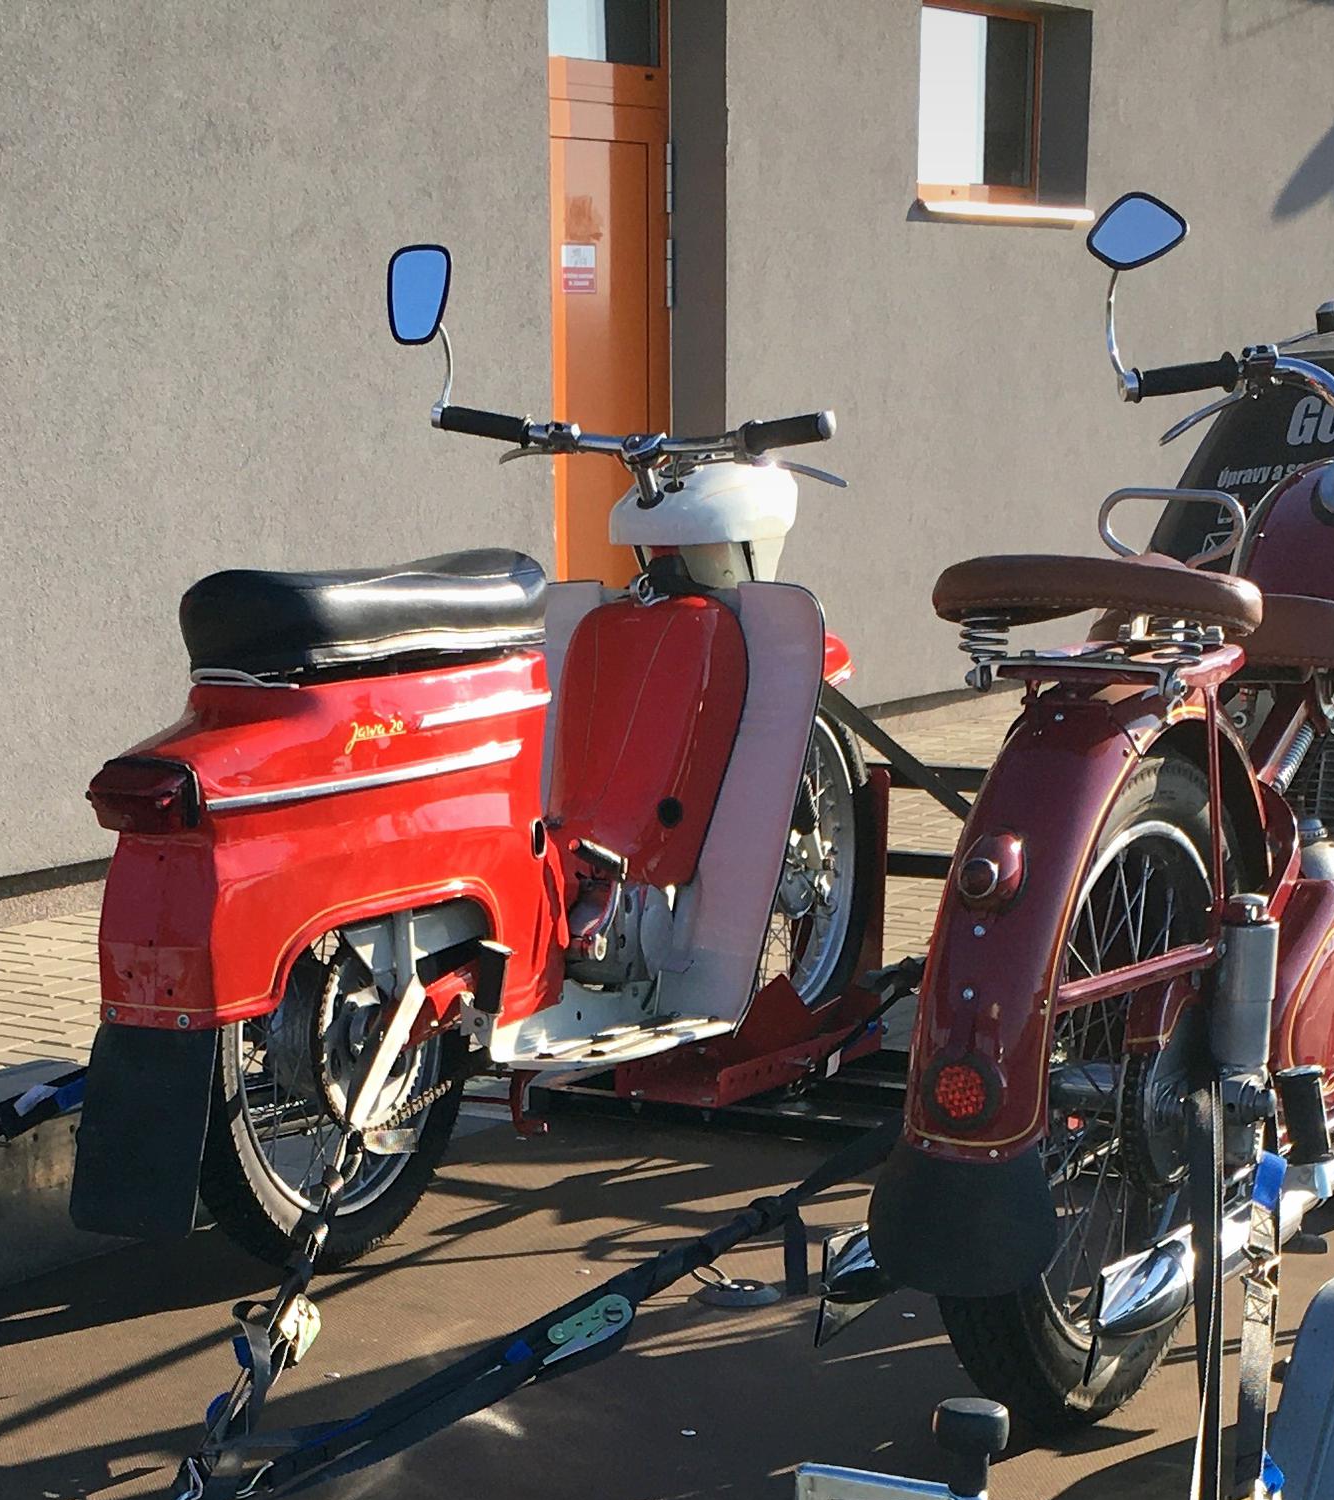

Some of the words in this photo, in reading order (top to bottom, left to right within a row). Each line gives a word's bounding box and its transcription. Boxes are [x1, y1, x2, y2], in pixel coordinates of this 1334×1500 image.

[1217, 465, 1272, 489] Úpravy
[1272, 467, 1284, 482] a
[389, 719, 404, 734] 20
